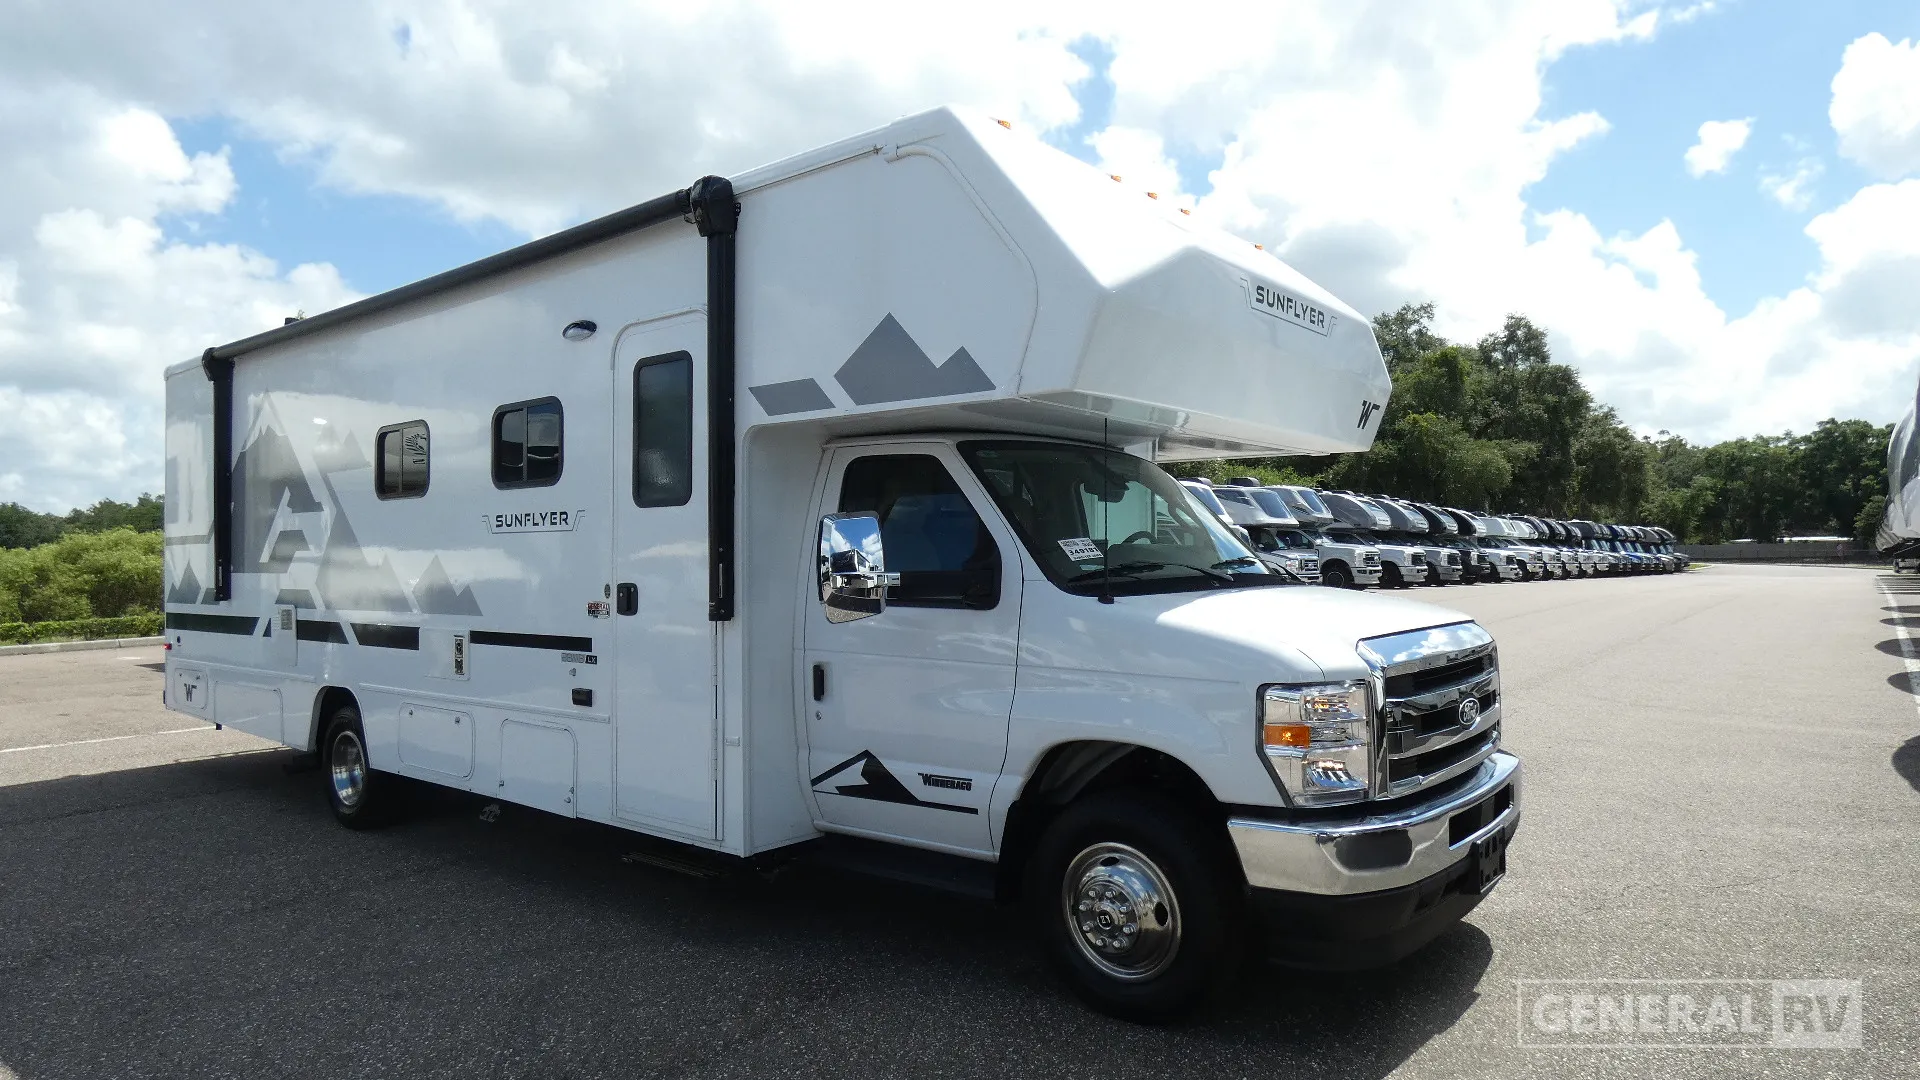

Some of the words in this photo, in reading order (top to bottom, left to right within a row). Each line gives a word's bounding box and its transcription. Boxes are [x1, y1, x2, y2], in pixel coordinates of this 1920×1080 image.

[1255, 284, 1325, 329] SUNFLYER
[495, 511, 569, 528] SUNFLYER
[918, 772, 973, 792] WINNEBAGO
